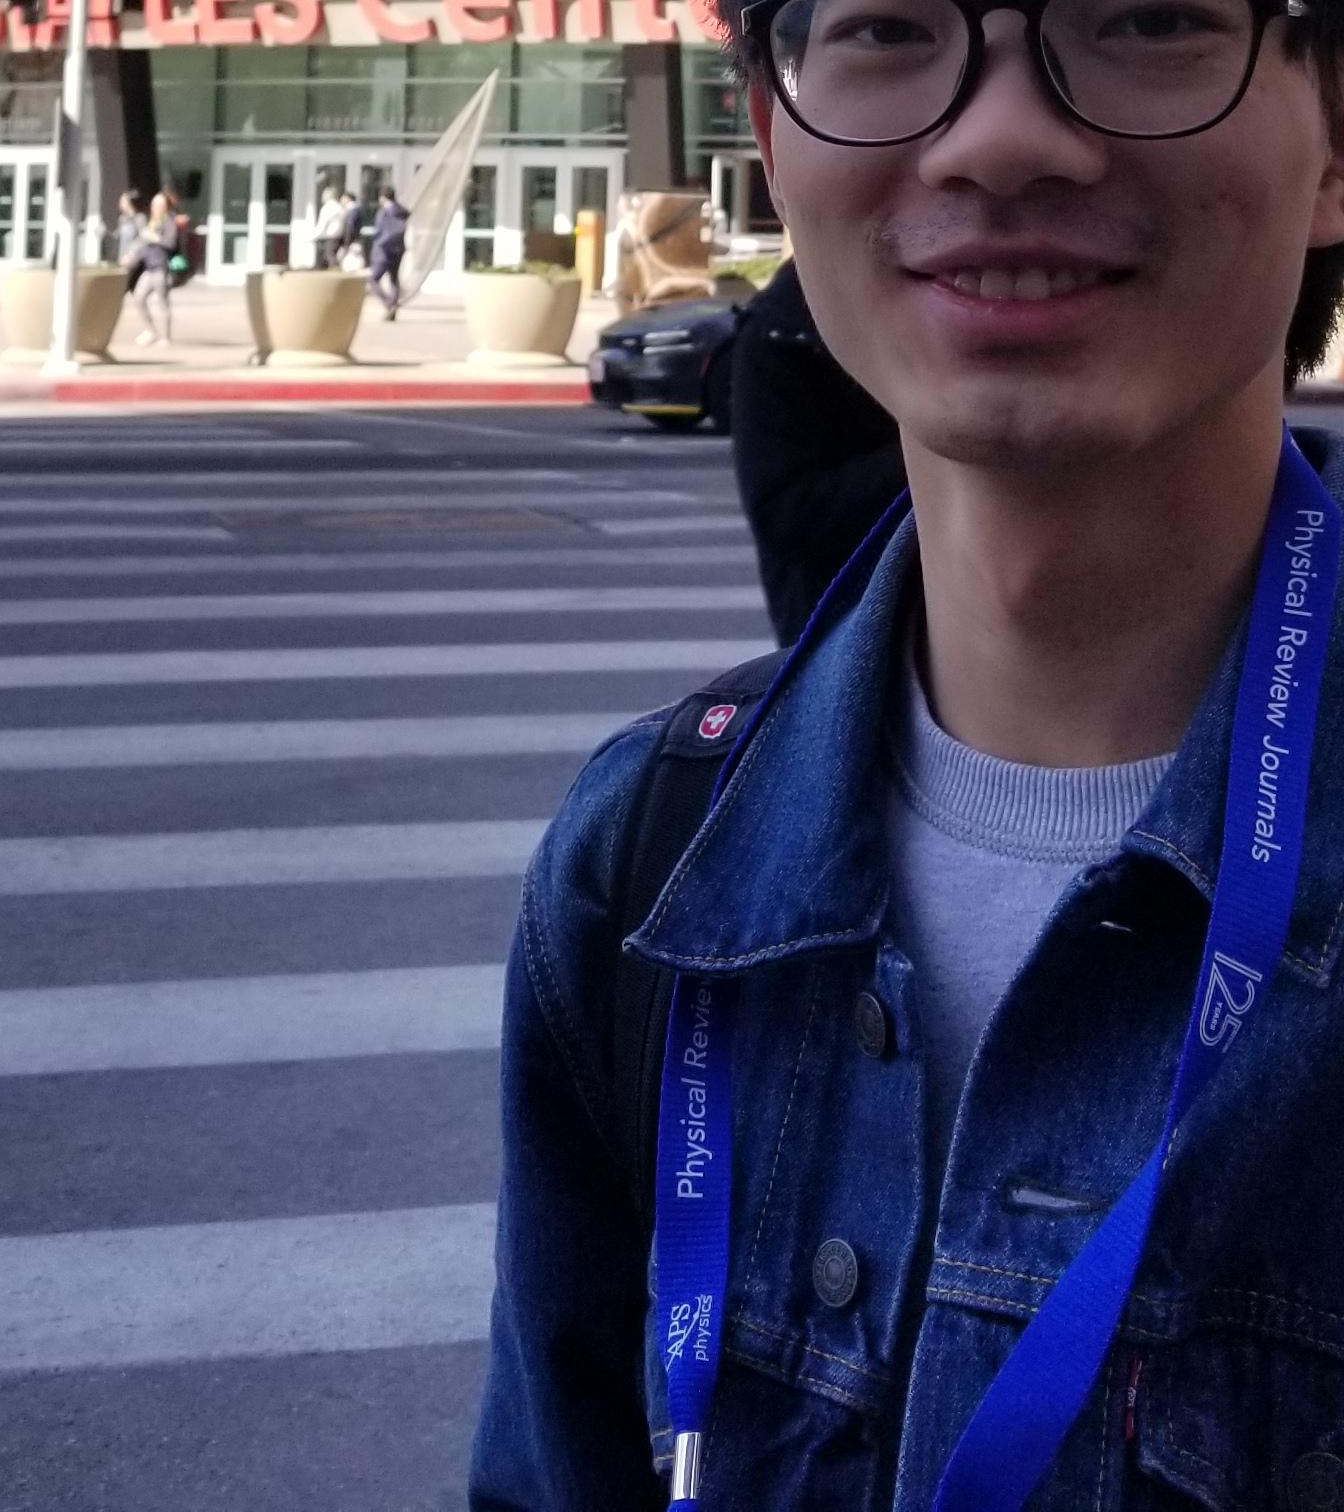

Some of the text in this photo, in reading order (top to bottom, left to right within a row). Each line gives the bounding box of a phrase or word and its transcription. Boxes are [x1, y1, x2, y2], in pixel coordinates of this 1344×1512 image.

[1251, 510, 1325, 863] Physical Review Journals
[1199, 951, 1264, 1054] 125
[676, 1077, 713, 1199] Physical
[667, 1303, 691, 1359] APS
[693, 1294, 713, 1362] physics
